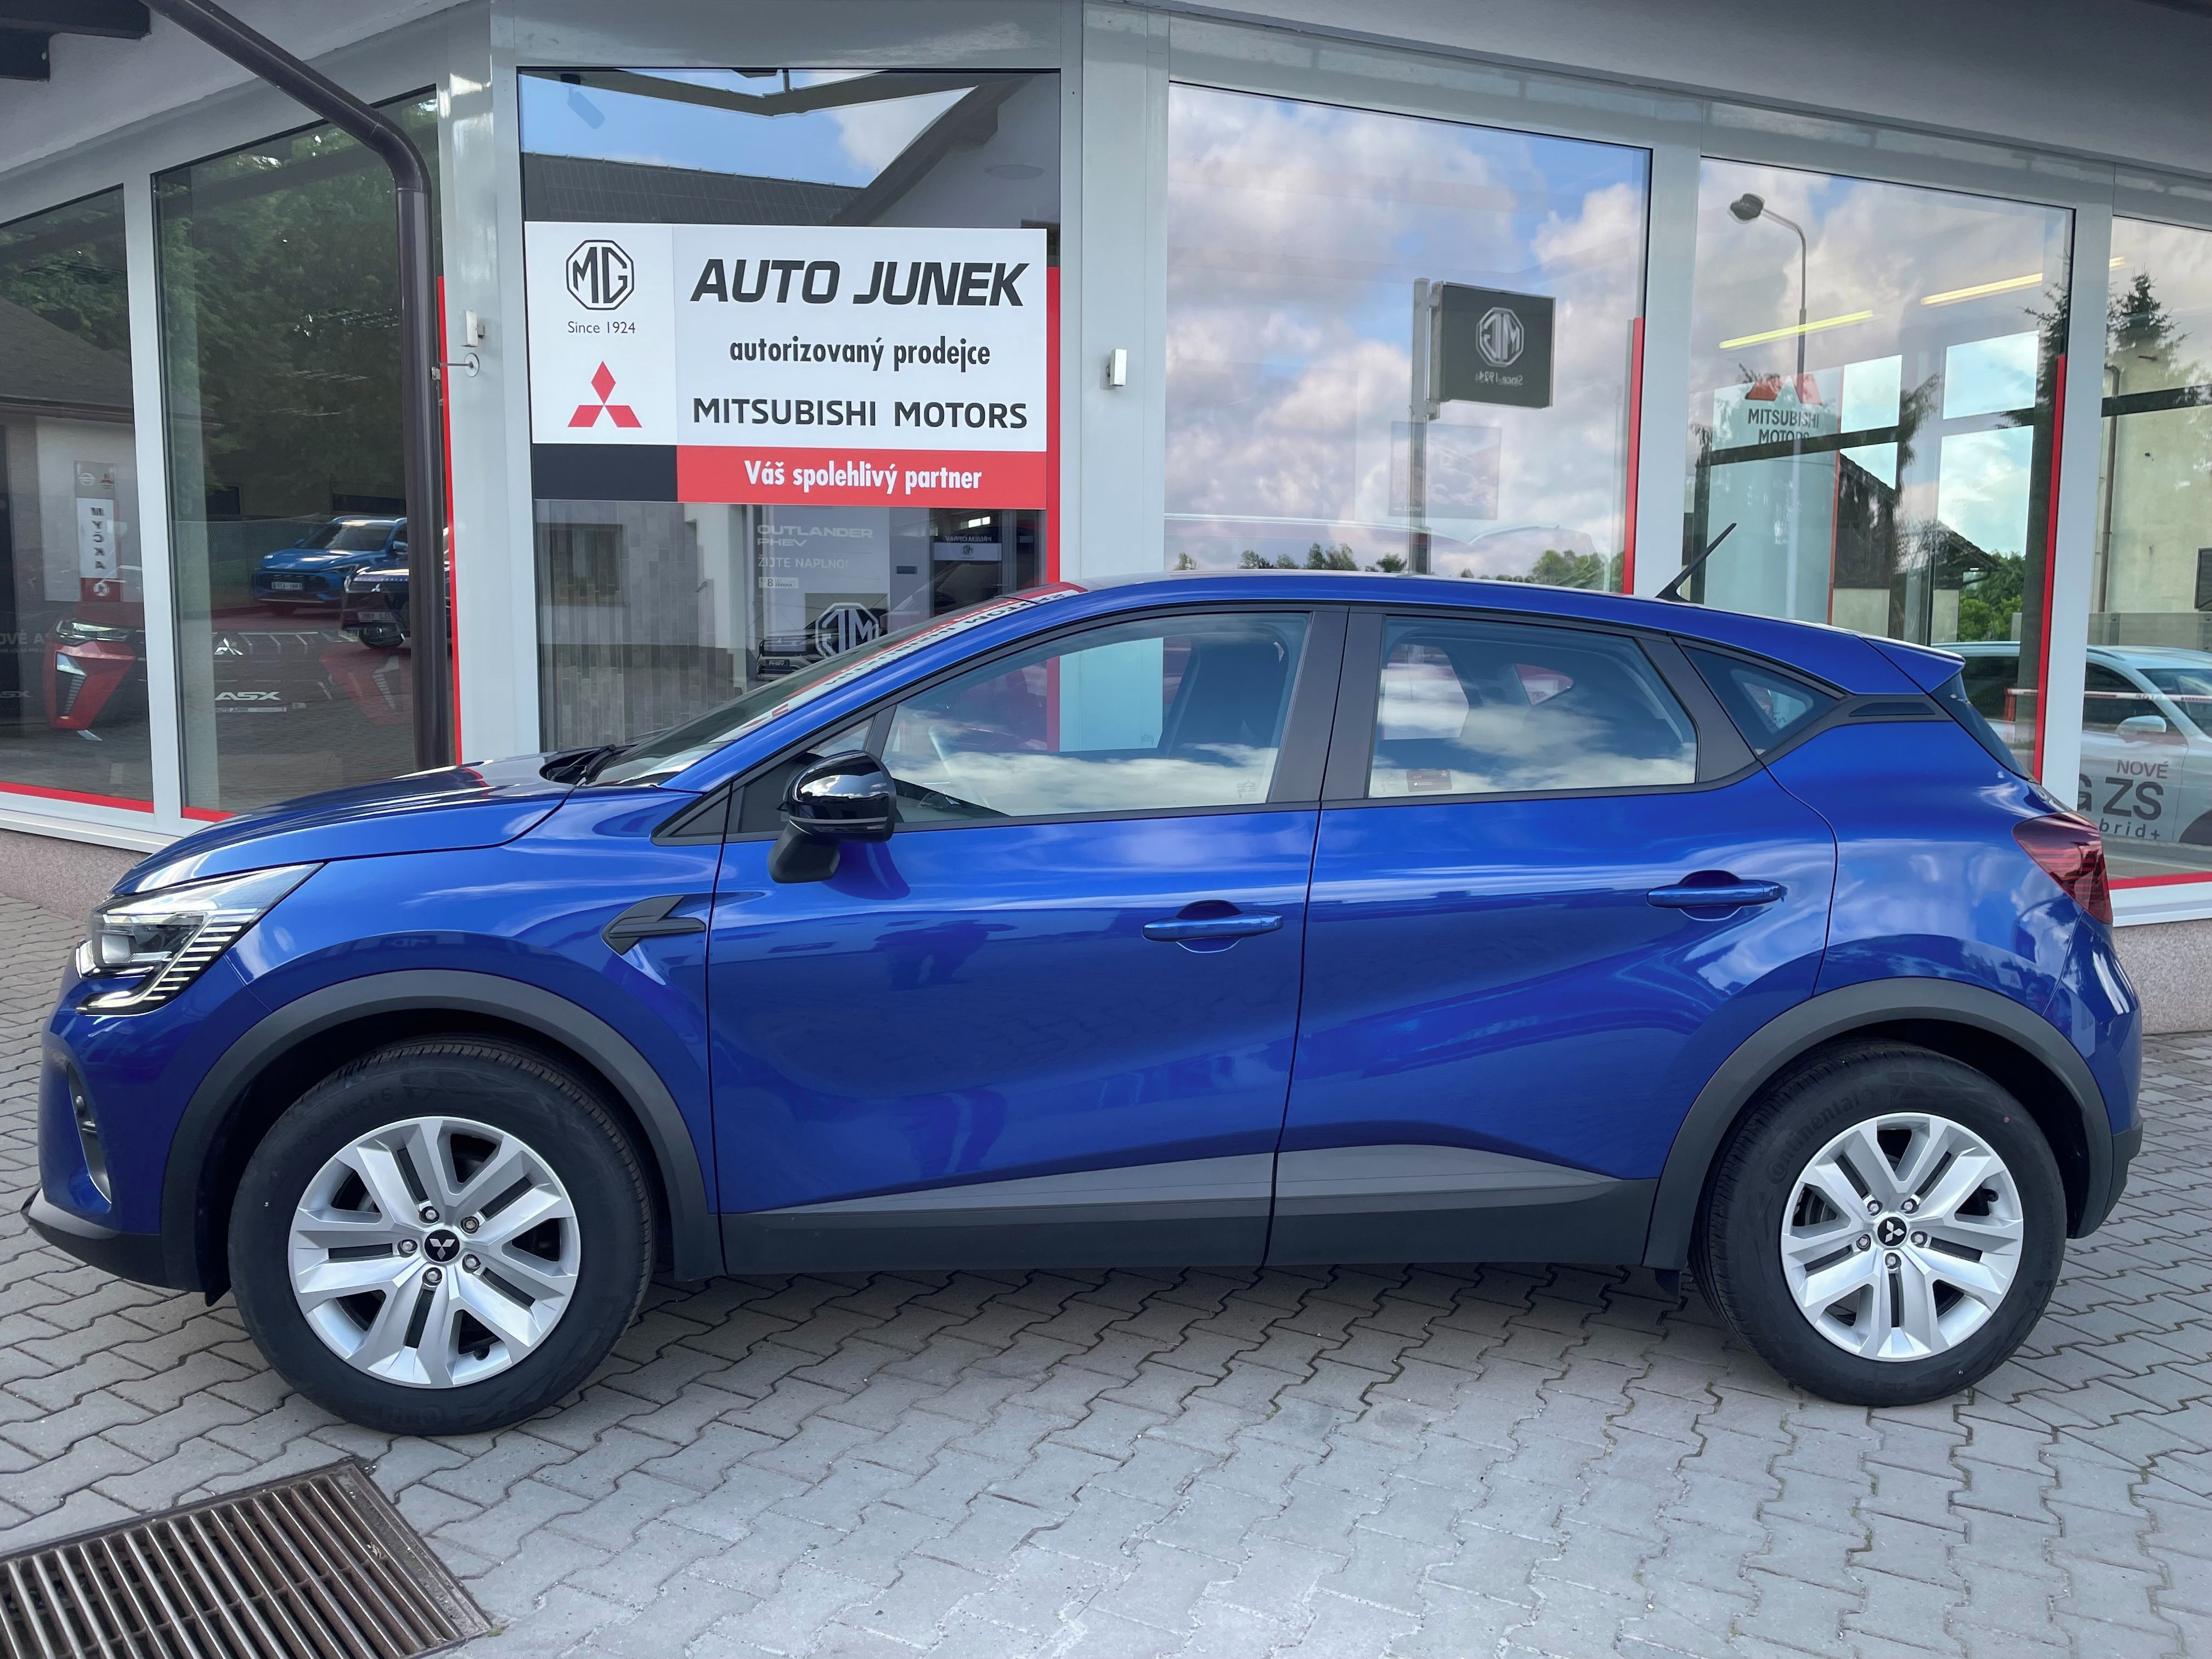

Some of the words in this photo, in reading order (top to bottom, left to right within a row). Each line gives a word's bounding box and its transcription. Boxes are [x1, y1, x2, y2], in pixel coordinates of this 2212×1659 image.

[571, 246, 629, 303] MG
[690, 259, 840, 303] AUTO
[853, 262, 1030, 306] JUNEK
[567, 321, 600, 334] Since
[607, 321, 636, 334] 1924
[730, 336, 884, 371] autorizovaný
[894, 336, 990, 373] prodejce
[693, 398, 876, 426] MITSUBISHI
[894, 402, 1027, 429] MOTORS
[1747, 408, 1820, 428] MITSUBISHI
[744, 460, 785, 485] Váš
[793, 460, 898, 495] spolehlivý
[905, 466, 982, 495] partner
[757, 524, 873, 538] OUTLANDER
[757, 538, 806, 546] PHEV
[758, 554, 791, 568] ŽIJTE
[795, 558, 848, 569] NAPLNO!
[767, 578, 774, 587] 8
[0, 690, 31, 698] SX
[215, 691, 281, 701] ASX
[2116, 759, 2169, 780] NOVÉ
[2103, 777, 2164, 821] ZS
